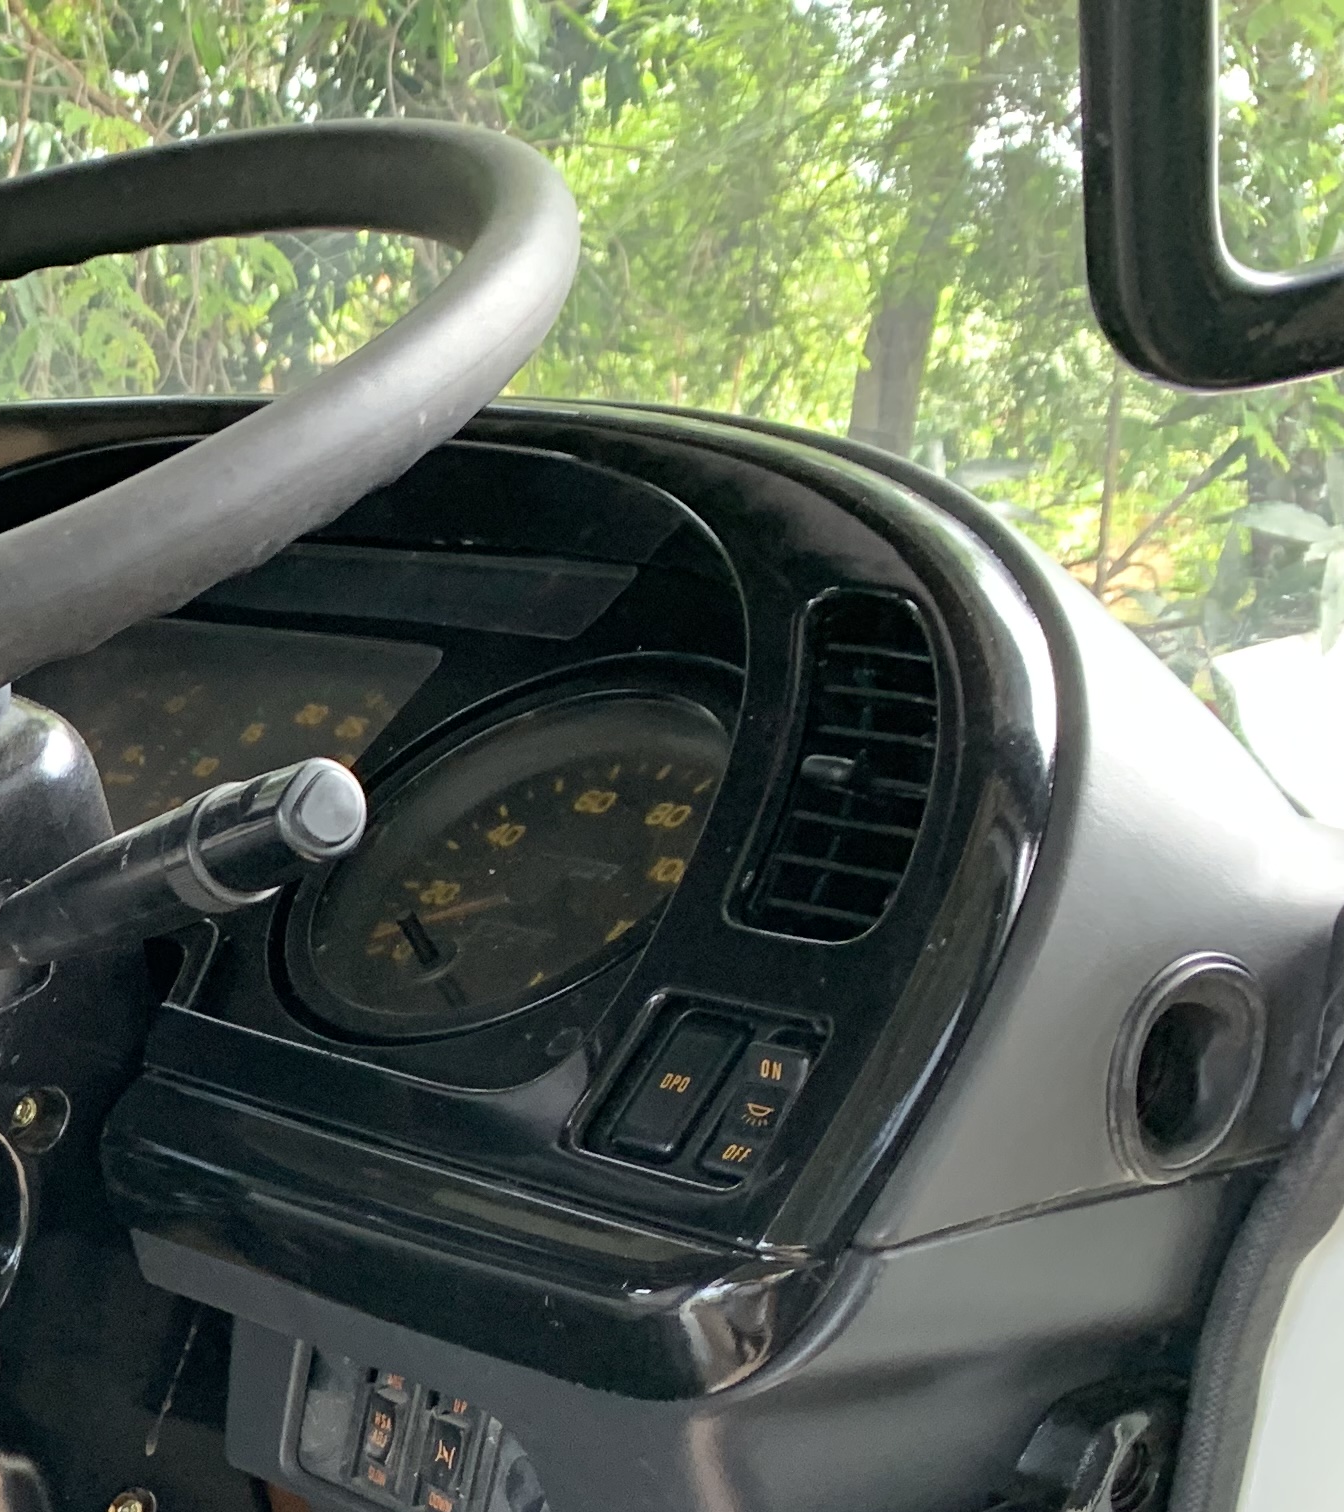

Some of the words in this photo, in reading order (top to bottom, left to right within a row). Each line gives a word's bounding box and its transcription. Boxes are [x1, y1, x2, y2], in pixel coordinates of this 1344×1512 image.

[644, 803, 692, 828] 80
[487, 823, 526, 847] 40
[760, 1059, 782, 1080] ON
[721, 1143, 752, 1162] OFF
[453, 1398, 468, 1414] UP
